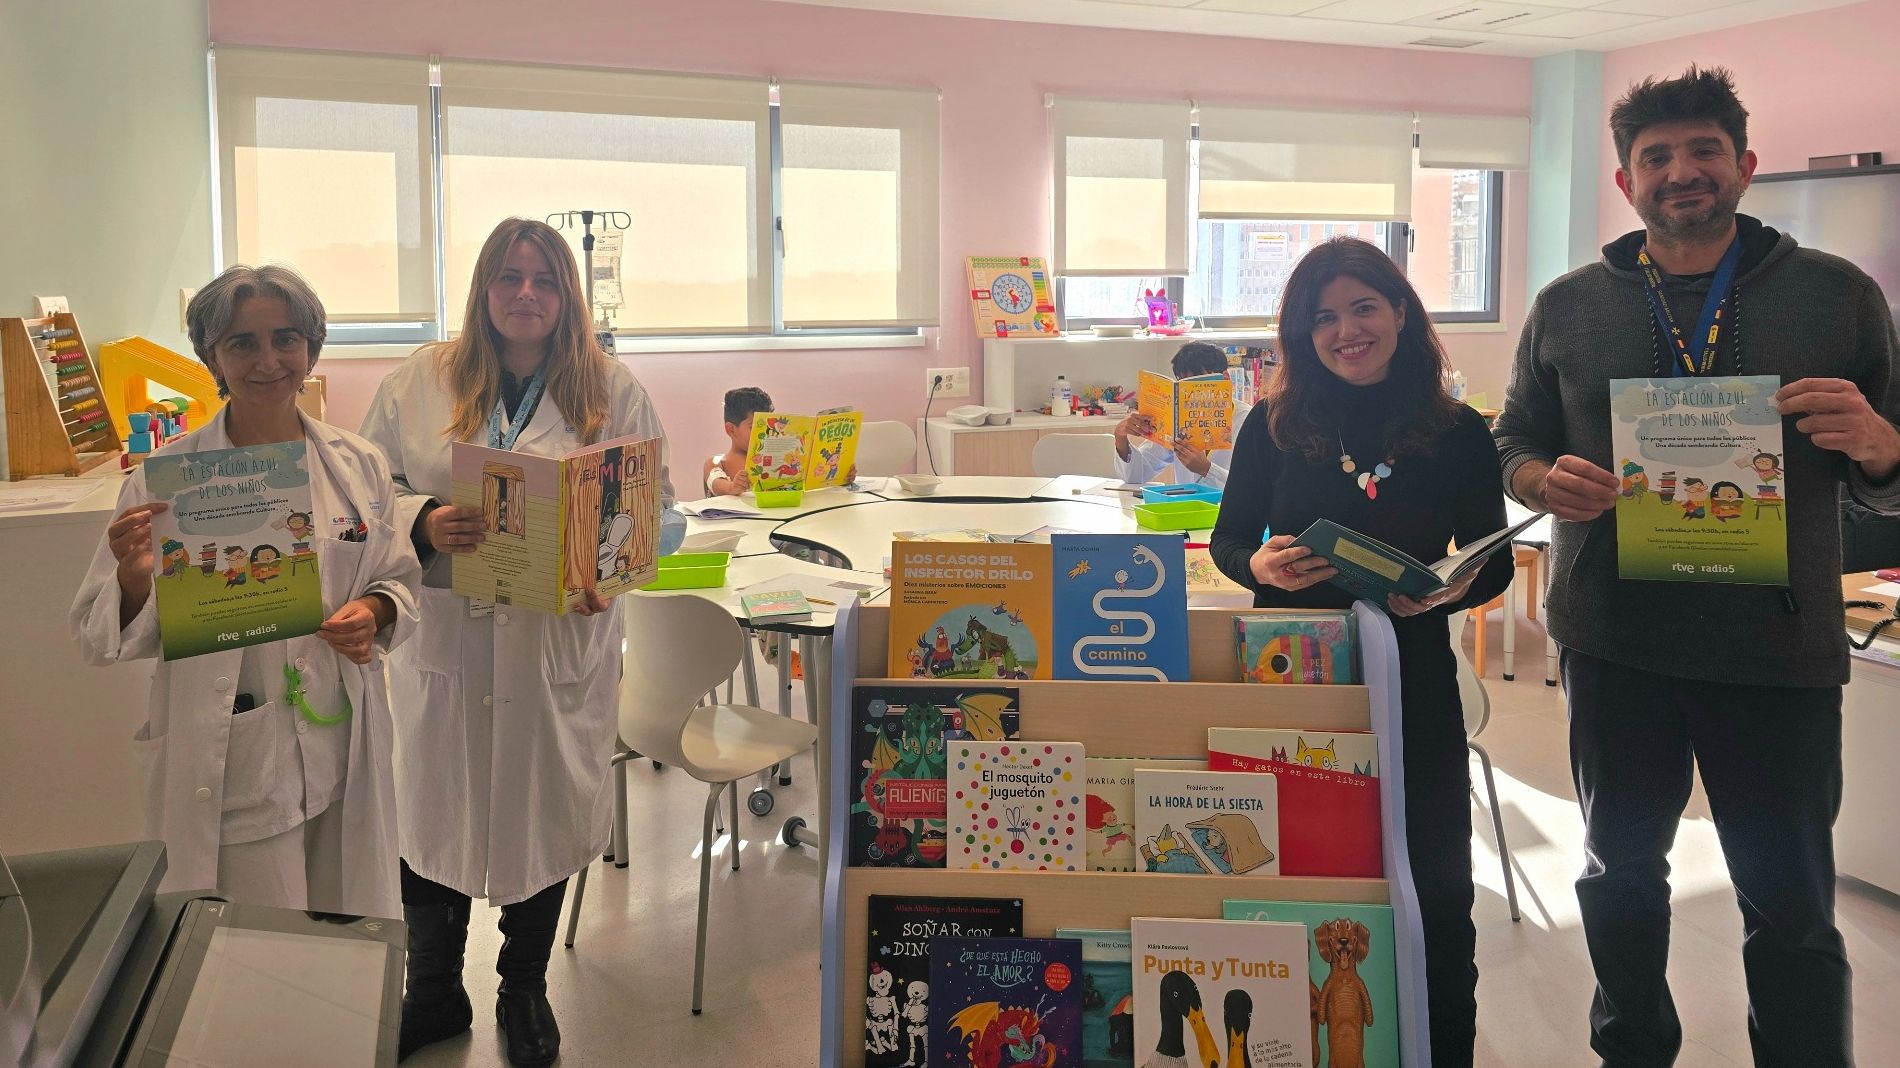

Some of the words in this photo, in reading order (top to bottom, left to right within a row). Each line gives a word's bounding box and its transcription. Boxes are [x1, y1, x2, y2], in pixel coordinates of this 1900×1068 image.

[1647, 392, 1658, 406] LA
[1665, 389, 1713, 405] ESTACIÓN
[1719, 390, 1746, 405] AZUL
[1662, 413, 1673, 427] DE
[1679, 413, 1697, 427] LOS
[1701, 411, 1732, 427] NIÑOS
[182, 466, 195, 481] LA
[201, 460, 248, 479] ESTACIÓN
[252, 458, 277, 473] AZUL
[199, 486, 210, 500] DE
[216, 483, 234, 498] LOS
[237, 479, 267, 495] NIÑOS
[188, 508, 215, 518] programa
[255, 506, 276, 514] Cultura
[904, 554, 933, 565] LOS
[935, 554, 987, 566] CASOS
[989, 555, 1018, 566] DEL
[904, 567, 986, 580] INSPECTOR
[988, 569, 1034, 581] DRILO
[1672, 562, 1695, 573] rtve
[1109, 621, 1124, 634] el
[217, 631, 240, 642] rtve
[1088, 648, 1147, 662] camino
[982, 770, 993, 782] El
[997, 771, 1053, 787] mosquito
[1231, 758, 1249, 770] Hay
[1254, 763, 1284, 775] gatos
[1290, 767, 1301, 777] en
[1307, 771, 1331, 781] este
[1336, 774, 1366, 787] libro
[989, 785, 1045, 800] juguetón
[1149, 796, 1161, 808] LA
[1165, 796, 1193, 809] HORA
[1196, 797, 1209, 809] DE
[1213, 798, 1225, 809] LA
[1229, 798, 1263, 811] SIESTA
[902, 919, 962, 938] SOÑAR
[1096, 941, 1111, 949] Kitty
[1011, 949, 1040, 964] HECHO
[976, 964, 991, 976] EL
[1144, 955, 1206, 976] Punta
[1211, 960, 1224, 981] y
[1226, 958, 1289, 979] Tunta
[1279, 1043, 1292, 1051] alto
[1271, 1050, 1293, 1060] cadena
